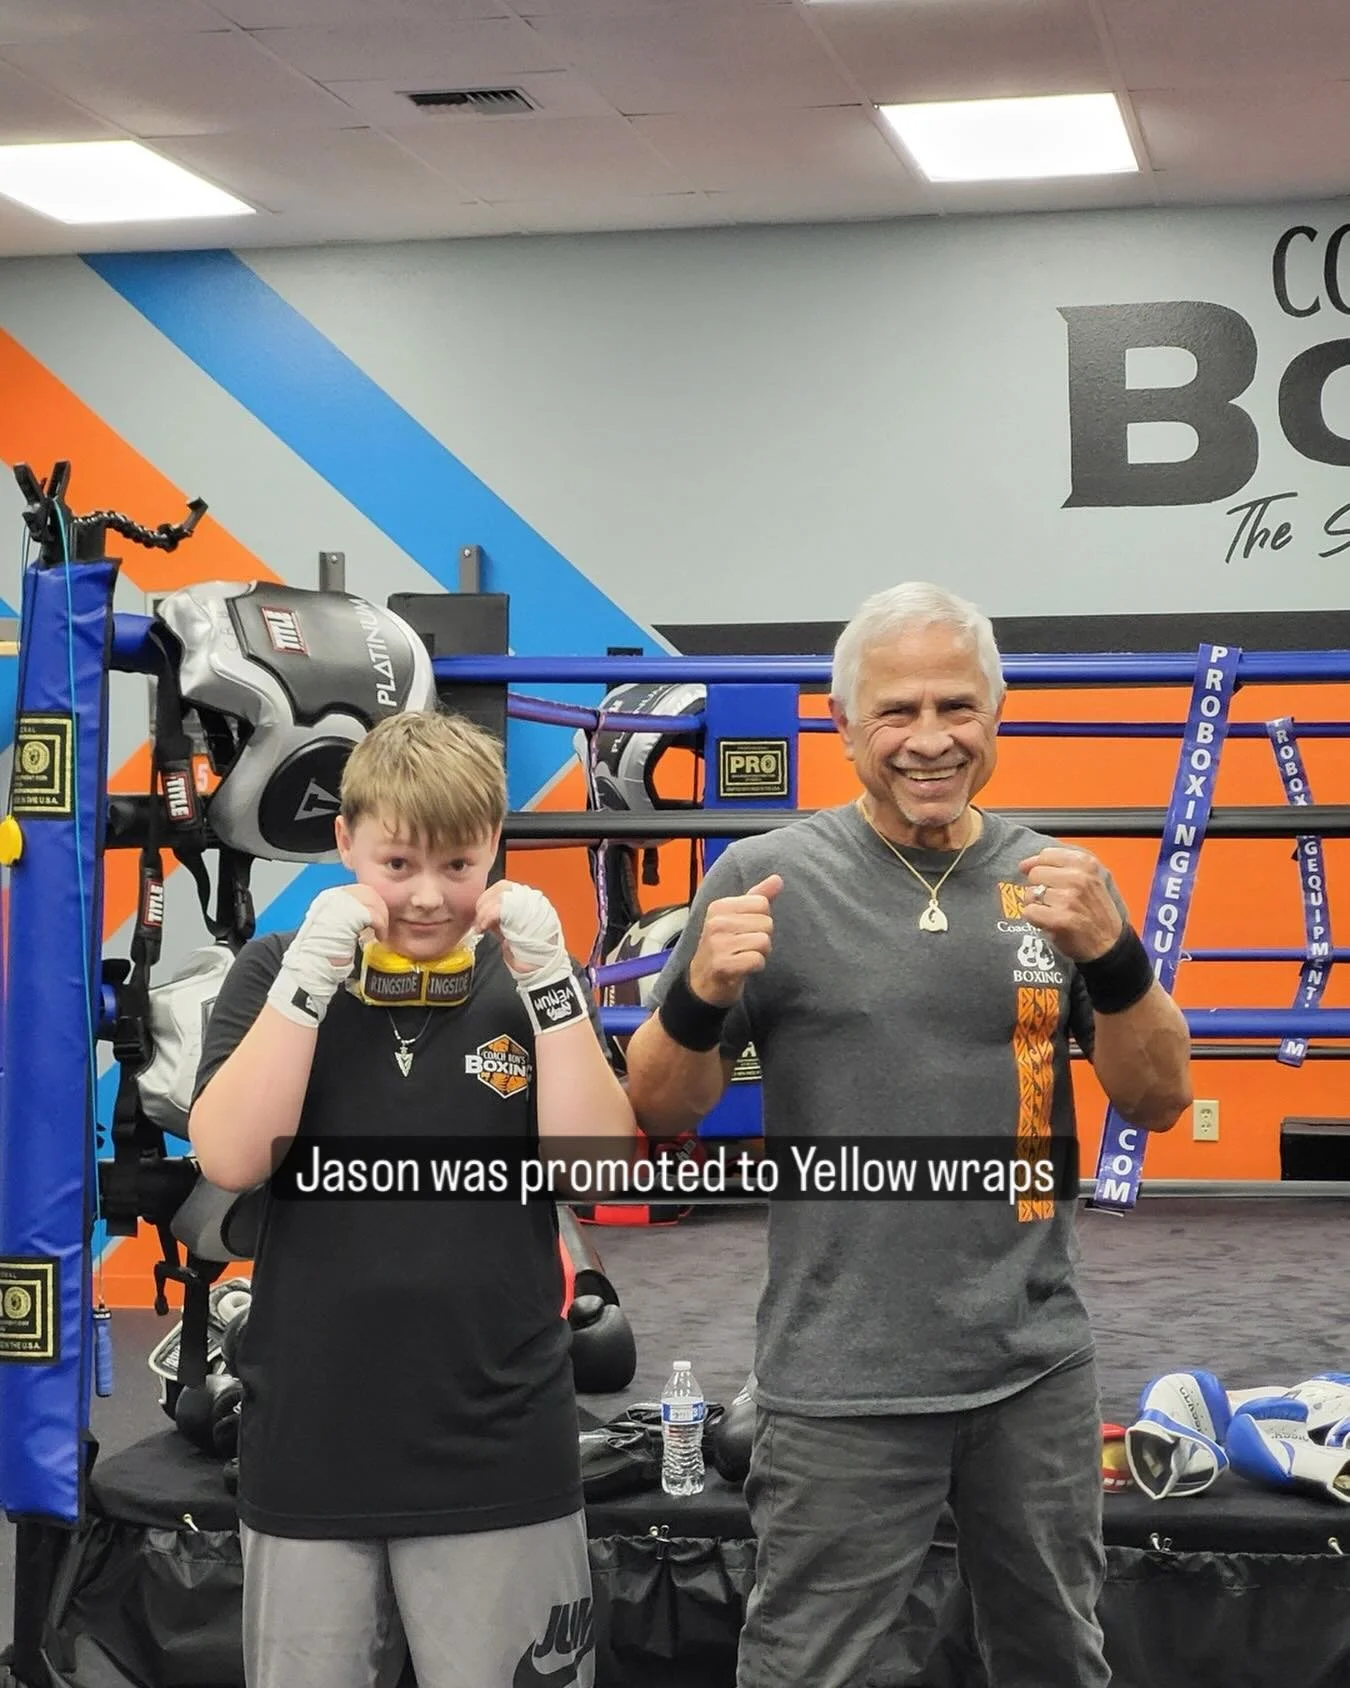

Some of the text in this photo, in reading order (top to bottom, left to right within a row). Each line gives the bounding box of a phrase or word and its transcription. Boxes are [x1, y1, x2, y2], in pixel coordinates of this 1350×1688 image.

[1225, 492, 1298, 563] The
[349, 598, 398, 707] PLATINUM
[730, 754, 777, 774] PRO
[166, 777, 190, 817] TITLE
[370, 974, 469, 995] RINGSIDE INGSIDE
[1013, 970, 1063, 985] BOXING
